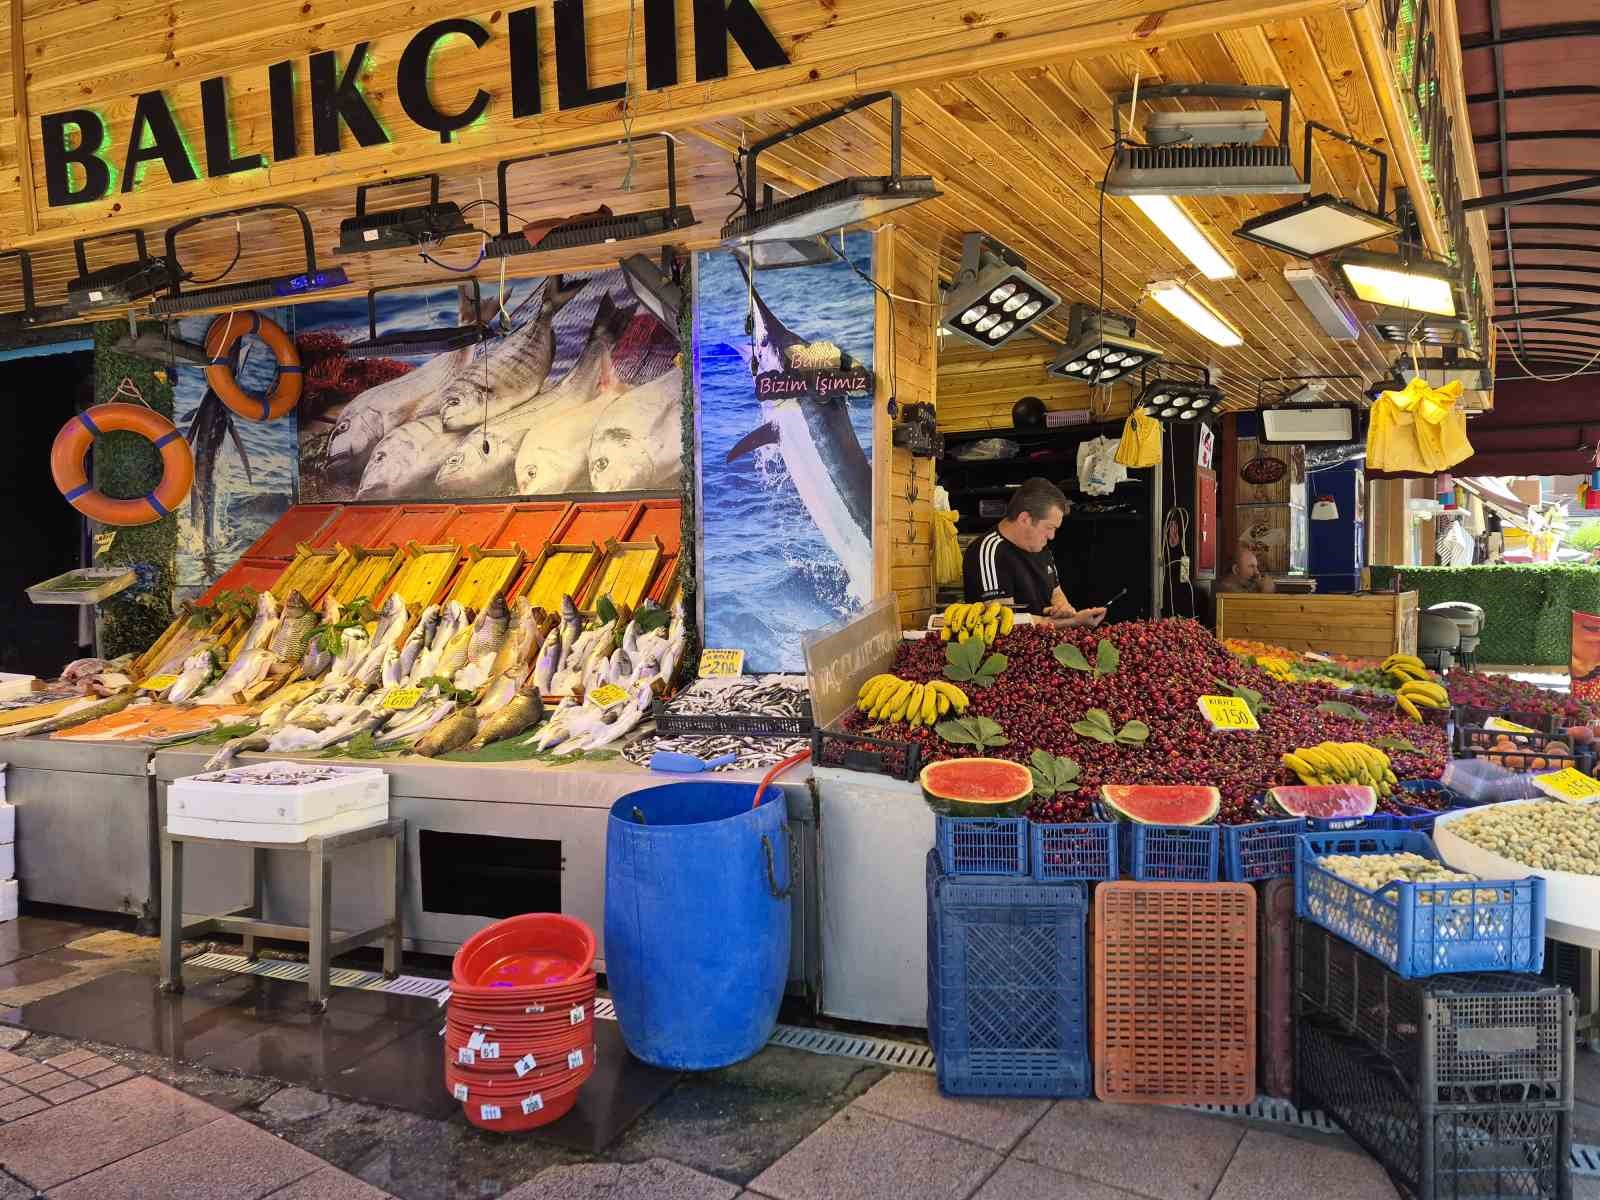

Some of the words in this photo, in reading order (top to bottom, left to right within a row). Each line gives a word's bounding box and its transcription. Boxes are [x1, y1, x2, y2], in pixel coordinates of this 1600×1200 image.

[41, 0, 792, 206] BALIKÇILIK
[760, 375, 808, 394] Bizim
[815, 371, 866, 395] İşimiz
